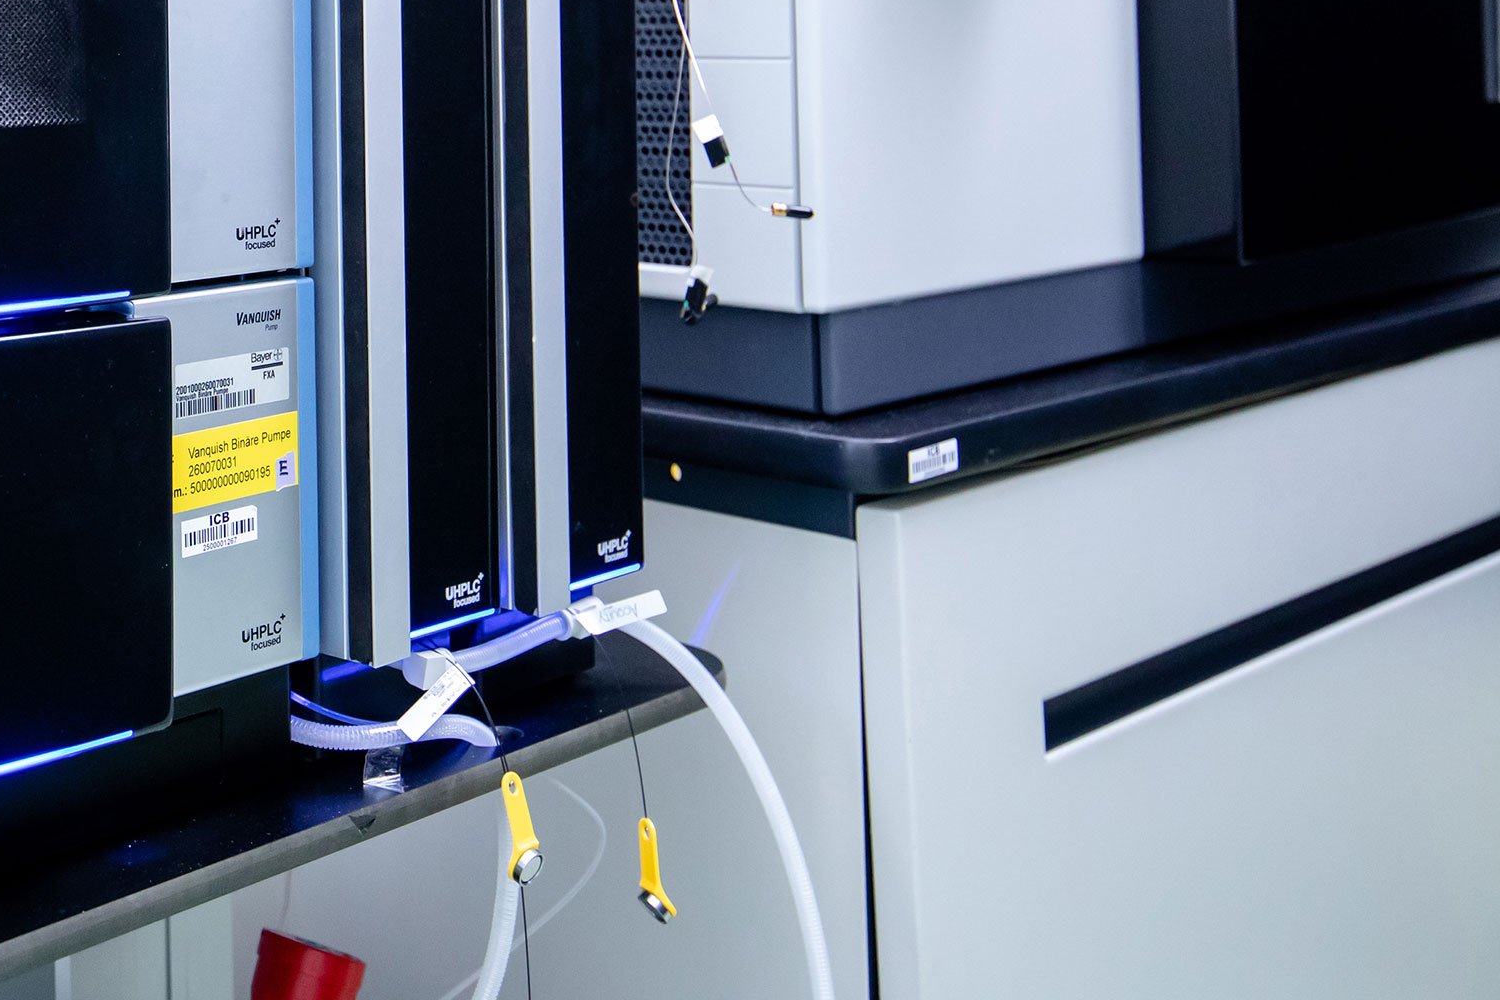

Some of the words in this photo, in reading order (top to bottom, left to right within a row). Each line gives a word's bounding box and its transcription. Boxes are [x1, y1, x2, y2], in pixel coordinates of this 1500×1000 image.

[245, 238, 276, 250] focused
[236, 309, 281, 326] VANQUISH
[265, 323, 278, 331] Pump
[251, 351, 273, 363] Bayer
[262, 370, 275, 380] FXA
[188, 441, 229, 459] Vanquish
[261, 429, 291, 443] Pumpe
[188, 456, 237, 477] 260070031
[279, 460, 289, 476] E
[209, 511, 230, 526] ICB
[453, 592, 480, 609] focused
[251, 634, 281, 651] focused
